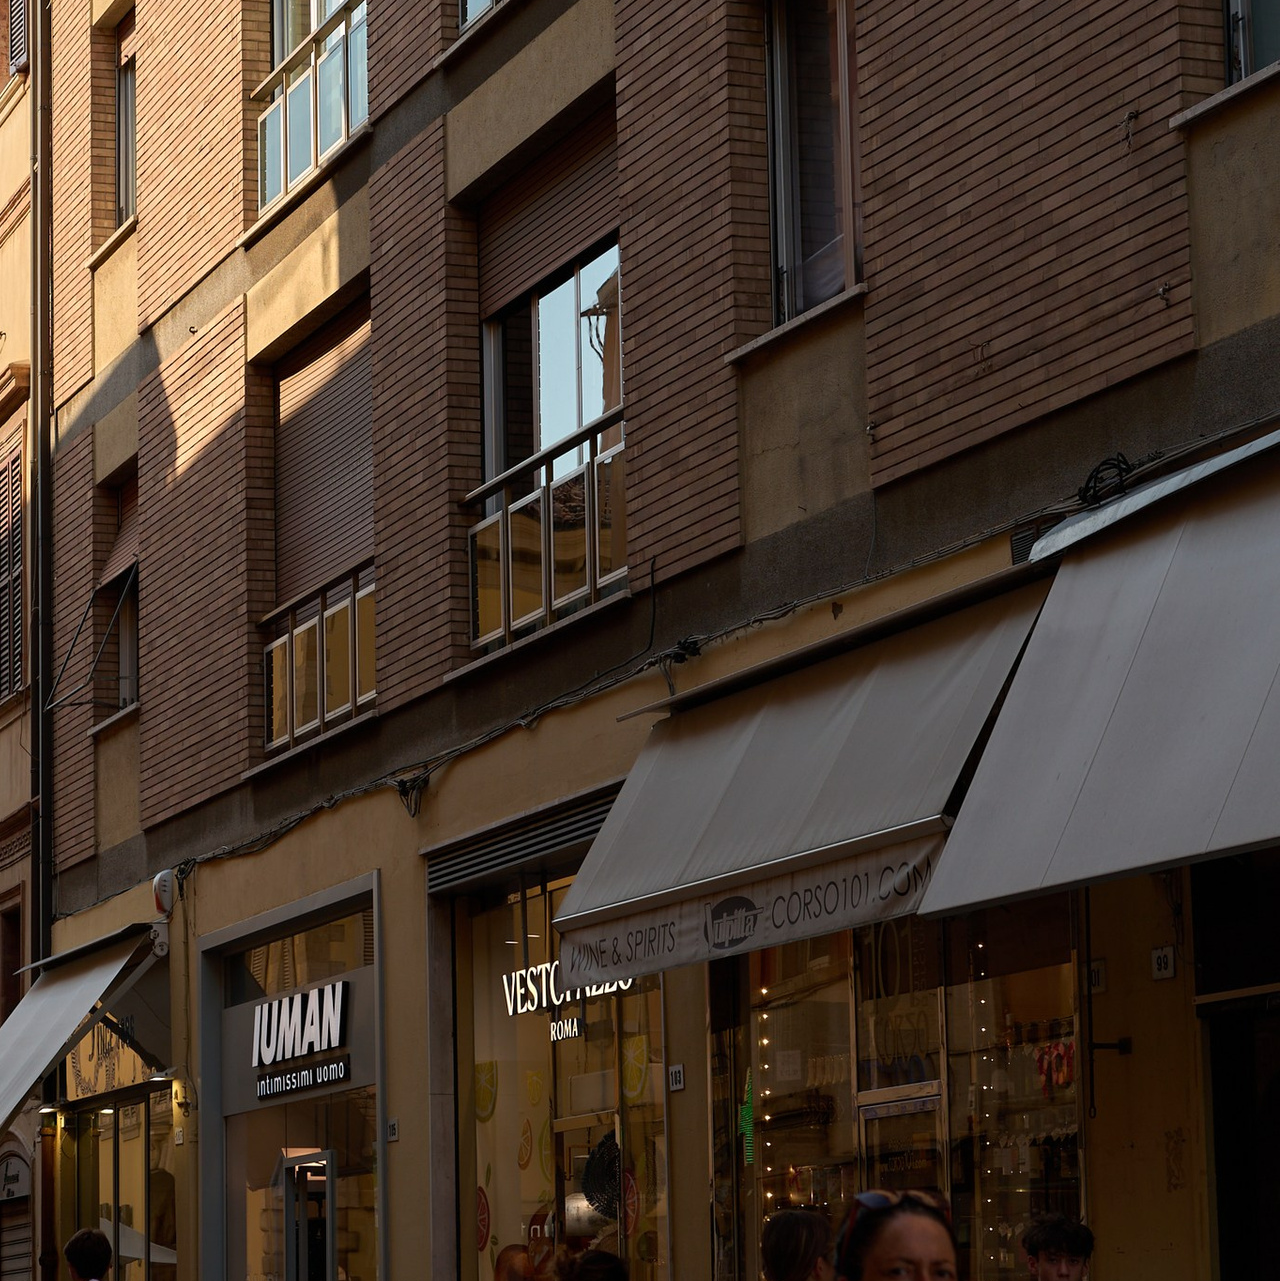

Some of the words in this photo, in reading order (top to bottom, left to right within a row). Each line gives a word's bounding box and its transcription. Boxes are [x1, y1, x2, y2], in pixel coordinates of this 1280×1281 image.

[570, 937, 607, 973] WINE
[612, 935, 623, 966] &
[626, 921, 677, 963] SPIRITS
[252, 981, 345, 1068] IUMAN
[550, 1017, 579, 1042] ROMA
[257, 1069, 313, 1097] intimissimi
[316, 1061, 345, 1083] uomo
[670, 1070, 681, 1087] 103
